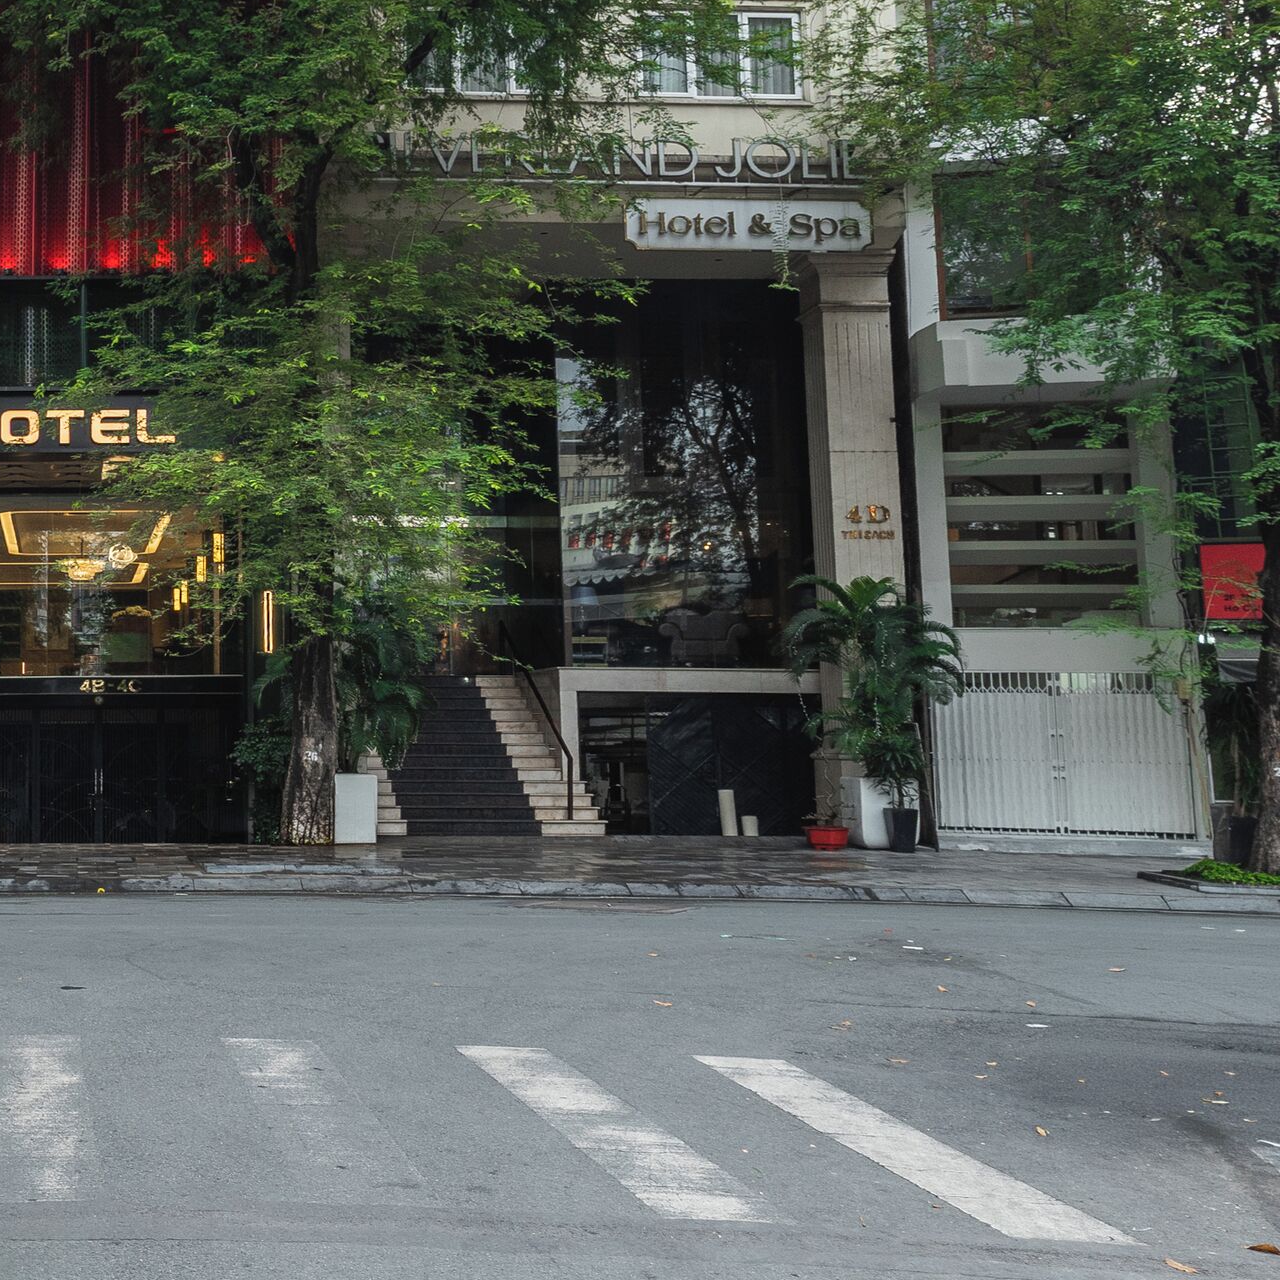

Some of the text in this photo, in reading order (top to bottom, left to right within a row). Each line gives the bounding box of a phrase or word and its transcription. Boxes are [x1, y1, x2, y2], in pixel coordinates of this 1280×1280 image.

[713, 138, 872, 179] JOLIE
[637, 211, 862, 243] Hotel & Spa
